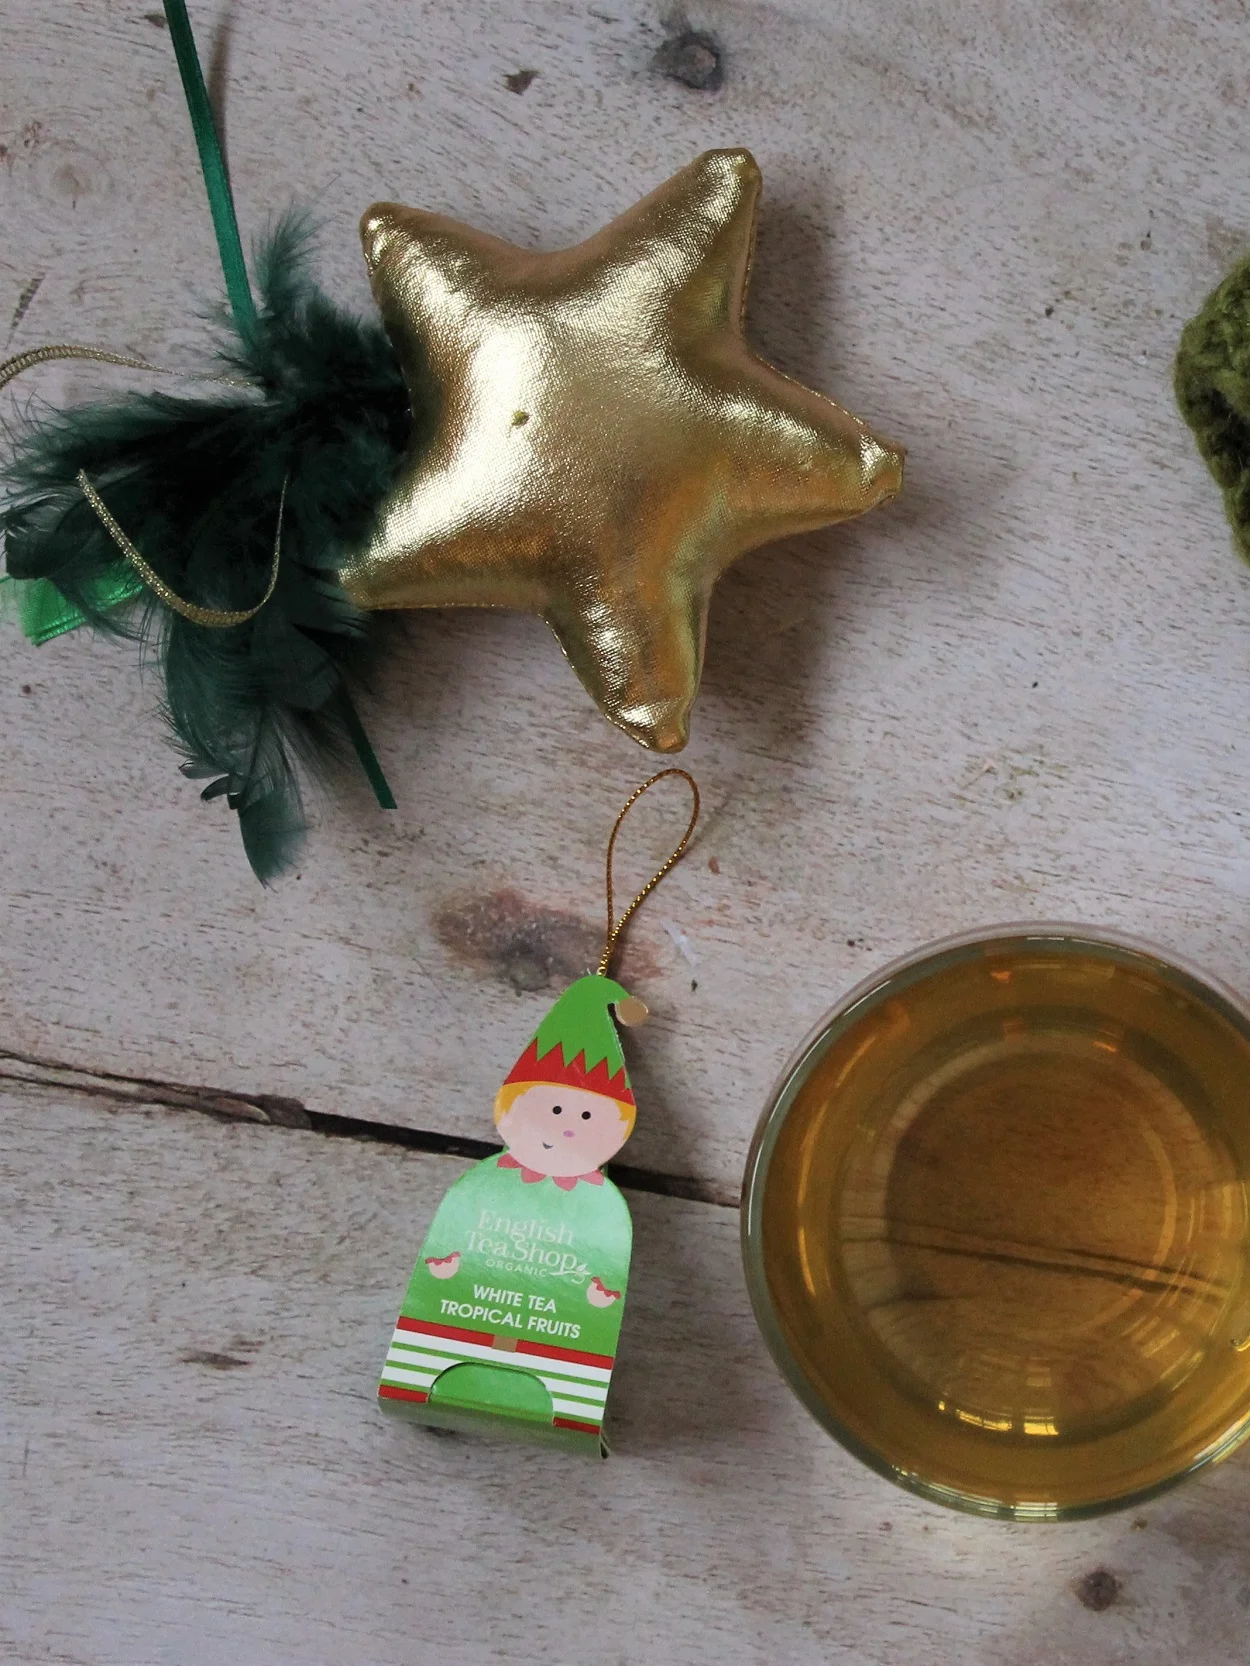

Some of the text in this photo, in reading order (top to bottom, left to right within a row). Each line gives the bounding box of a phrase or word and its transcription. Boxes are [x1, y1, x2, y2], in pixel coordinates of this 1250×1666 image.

[478, 1209, 574, 1247] English
[485, 1258, 548, 1278] ORGANIC
[473, 1284, 557, 1313] WHITE TEA
[440, 1299, 581, 1339] TROPICAL FRUITS
